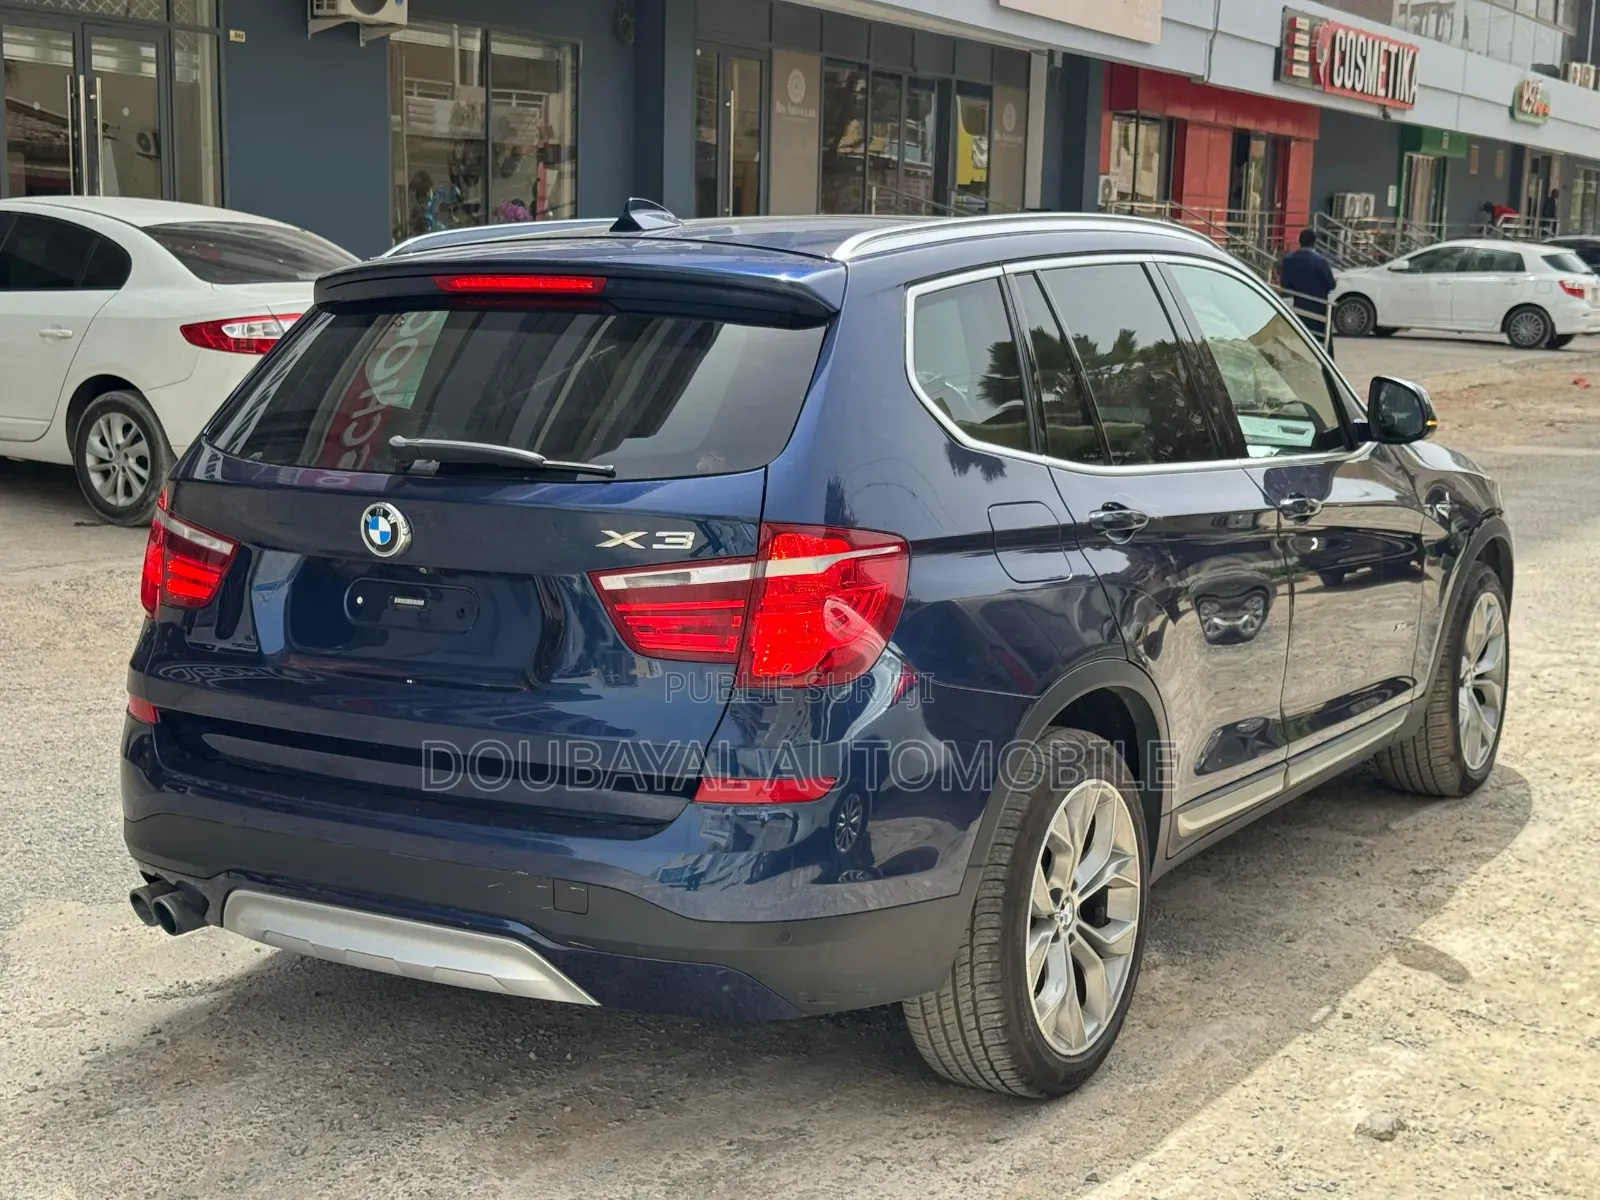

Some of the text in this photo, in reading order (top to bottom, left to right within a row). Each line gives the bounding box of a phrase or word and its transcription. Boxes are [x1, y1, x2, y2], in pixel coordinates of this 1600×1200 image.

[1333, 28, 1420, 105] COSMETIKA
[365, 508, 396, 525] BMW
[594, 529, 696, 550] X3
